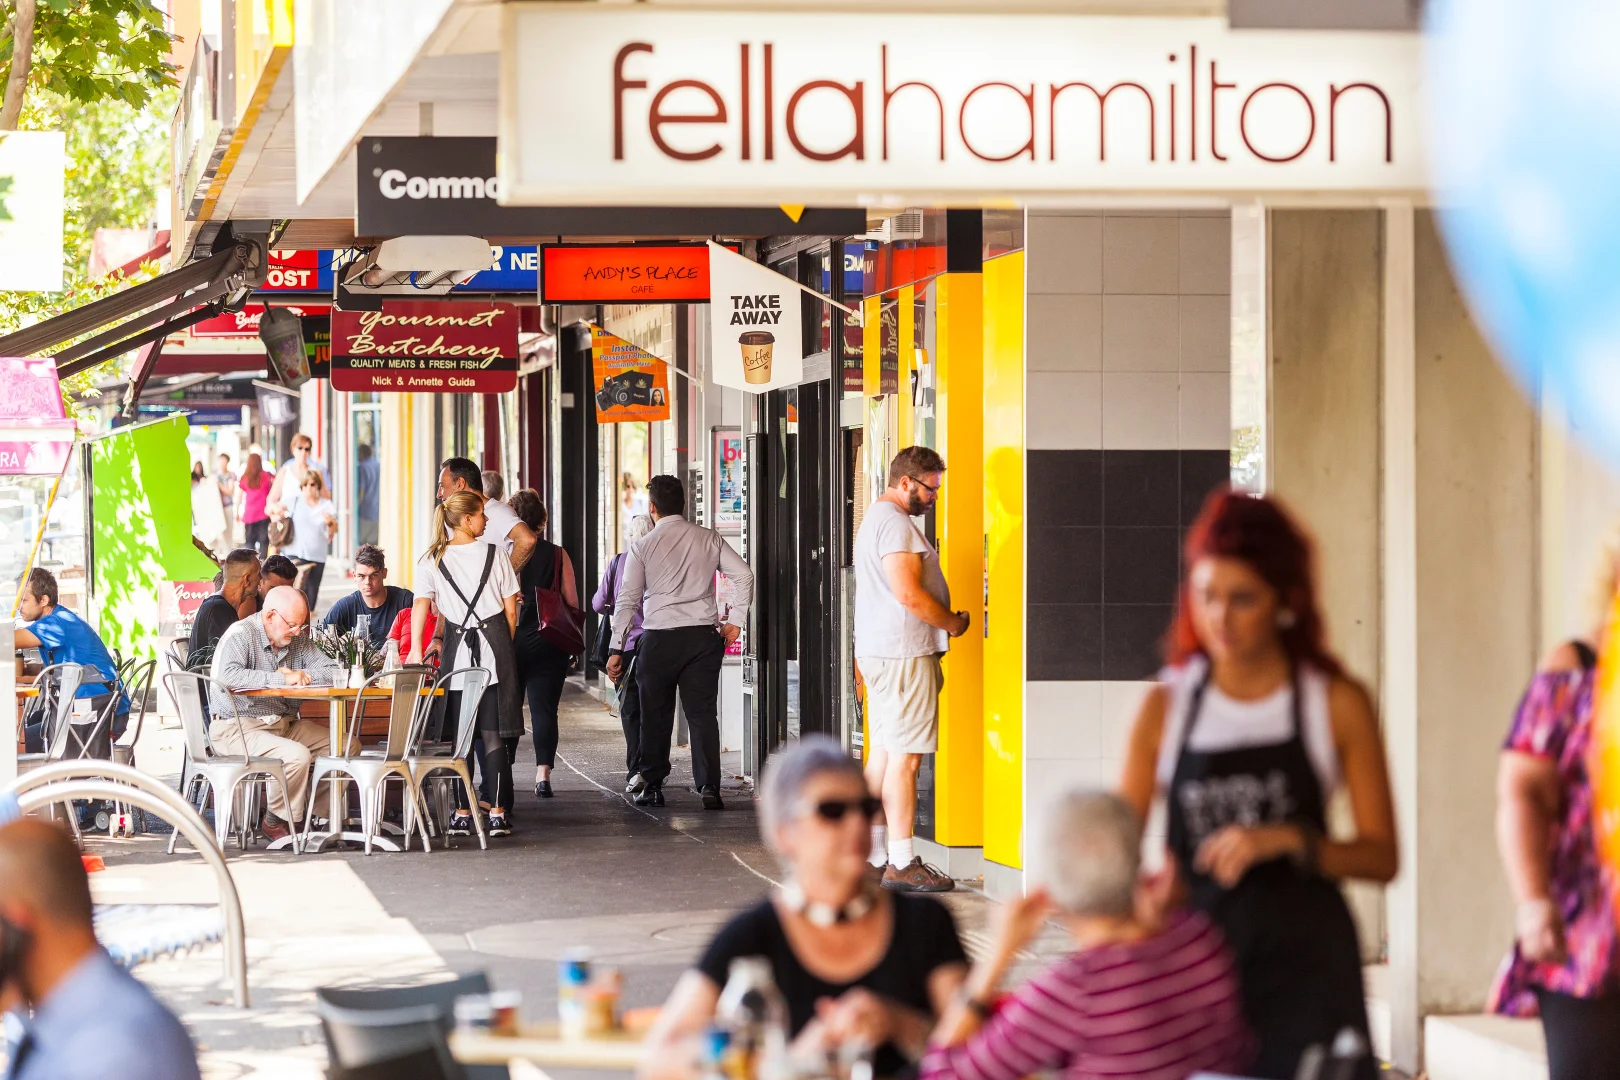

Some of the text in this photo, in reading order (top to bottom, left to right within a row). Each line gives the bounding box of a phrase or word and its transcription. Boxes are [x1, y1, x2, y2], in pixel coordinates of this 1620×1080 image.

[613, 42, 1392, 162] fellahamilton
[266, 270, 311, 287] OST
[583, 266, 699, 281] ANDY'S PLACE
[631, 284, 654, 294] CAFÉ
[730, 294, 781, 309] TAKE
[359, 307, 505, 335] Gourmet
[730, 310, 782, 325] AWAY
[347, 335, 504, 369] Butchery
[744, 348, 771, 367] Coffee
[350, 359, 480, 370] QUALITY MEATS & FRESH FISH
[372, 376, 476, 387] Nick & Annette Guida
